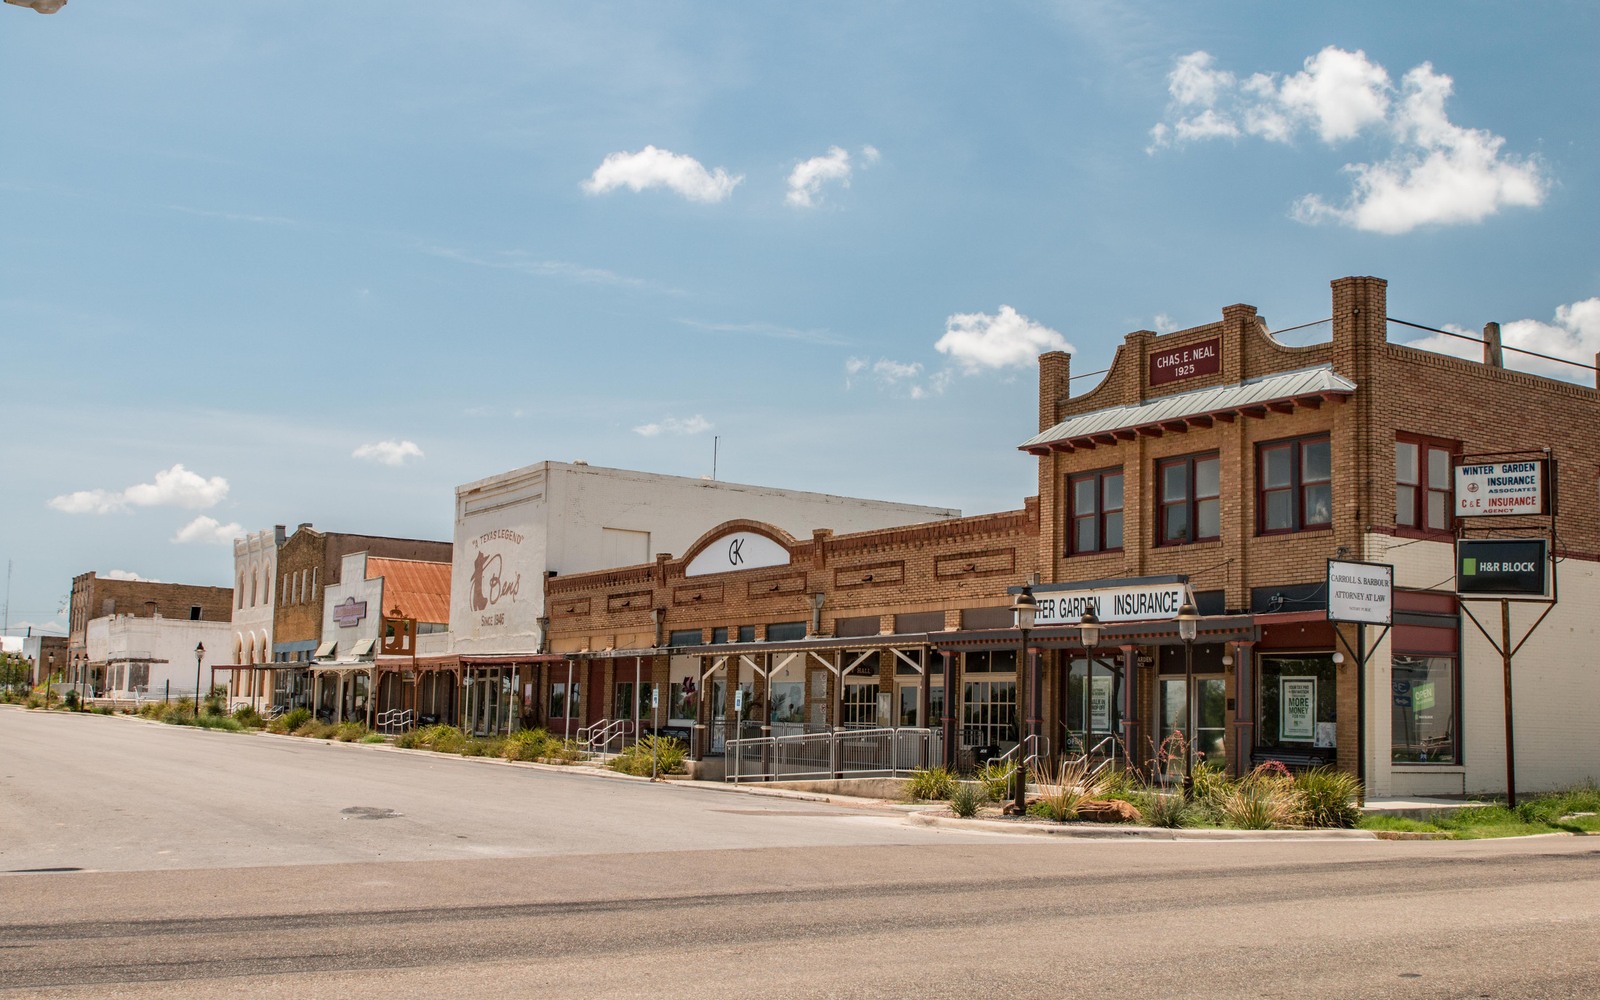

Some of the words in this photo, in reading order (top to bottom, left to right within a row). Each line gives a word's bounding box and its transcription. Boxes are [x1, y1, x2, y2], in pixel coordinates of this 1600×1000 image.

[1193, 346, 1215, 360] NEAL
[1175, 365, 1195, 377] 1925
[1462, 465, 1494, 475] WINTER
[1502, 463, 1535, 473] GARDEN
[1487, 475, 1536, 486] INSURANCE
[1461, 499, 1467, 508] C
[1475, 499, 1481, 507] E
[1488, 496, 1537, 507] INSURANCE
[480, 530, 497, 544] TEXAS
[1479, 562, 1500, 572] H&R
[1502, 562, 1535, 572] BLOCK
[1331, 574, 1357, 584] CARROLL
[1363, 577, 1390, 587] BARBOUR
[1335, 590, 1364, 601] ATTORNEY
[1365, 593, 1373, 601] AT
[1373, 594, 1386, 602] LAW
[1034, 598, 1055, 619] TER
[1114, 591, 1179, 616] INSURANCE
[1415, 688, 1432, 700] OPEN
[1289, 697, 1309, 706] MORE
